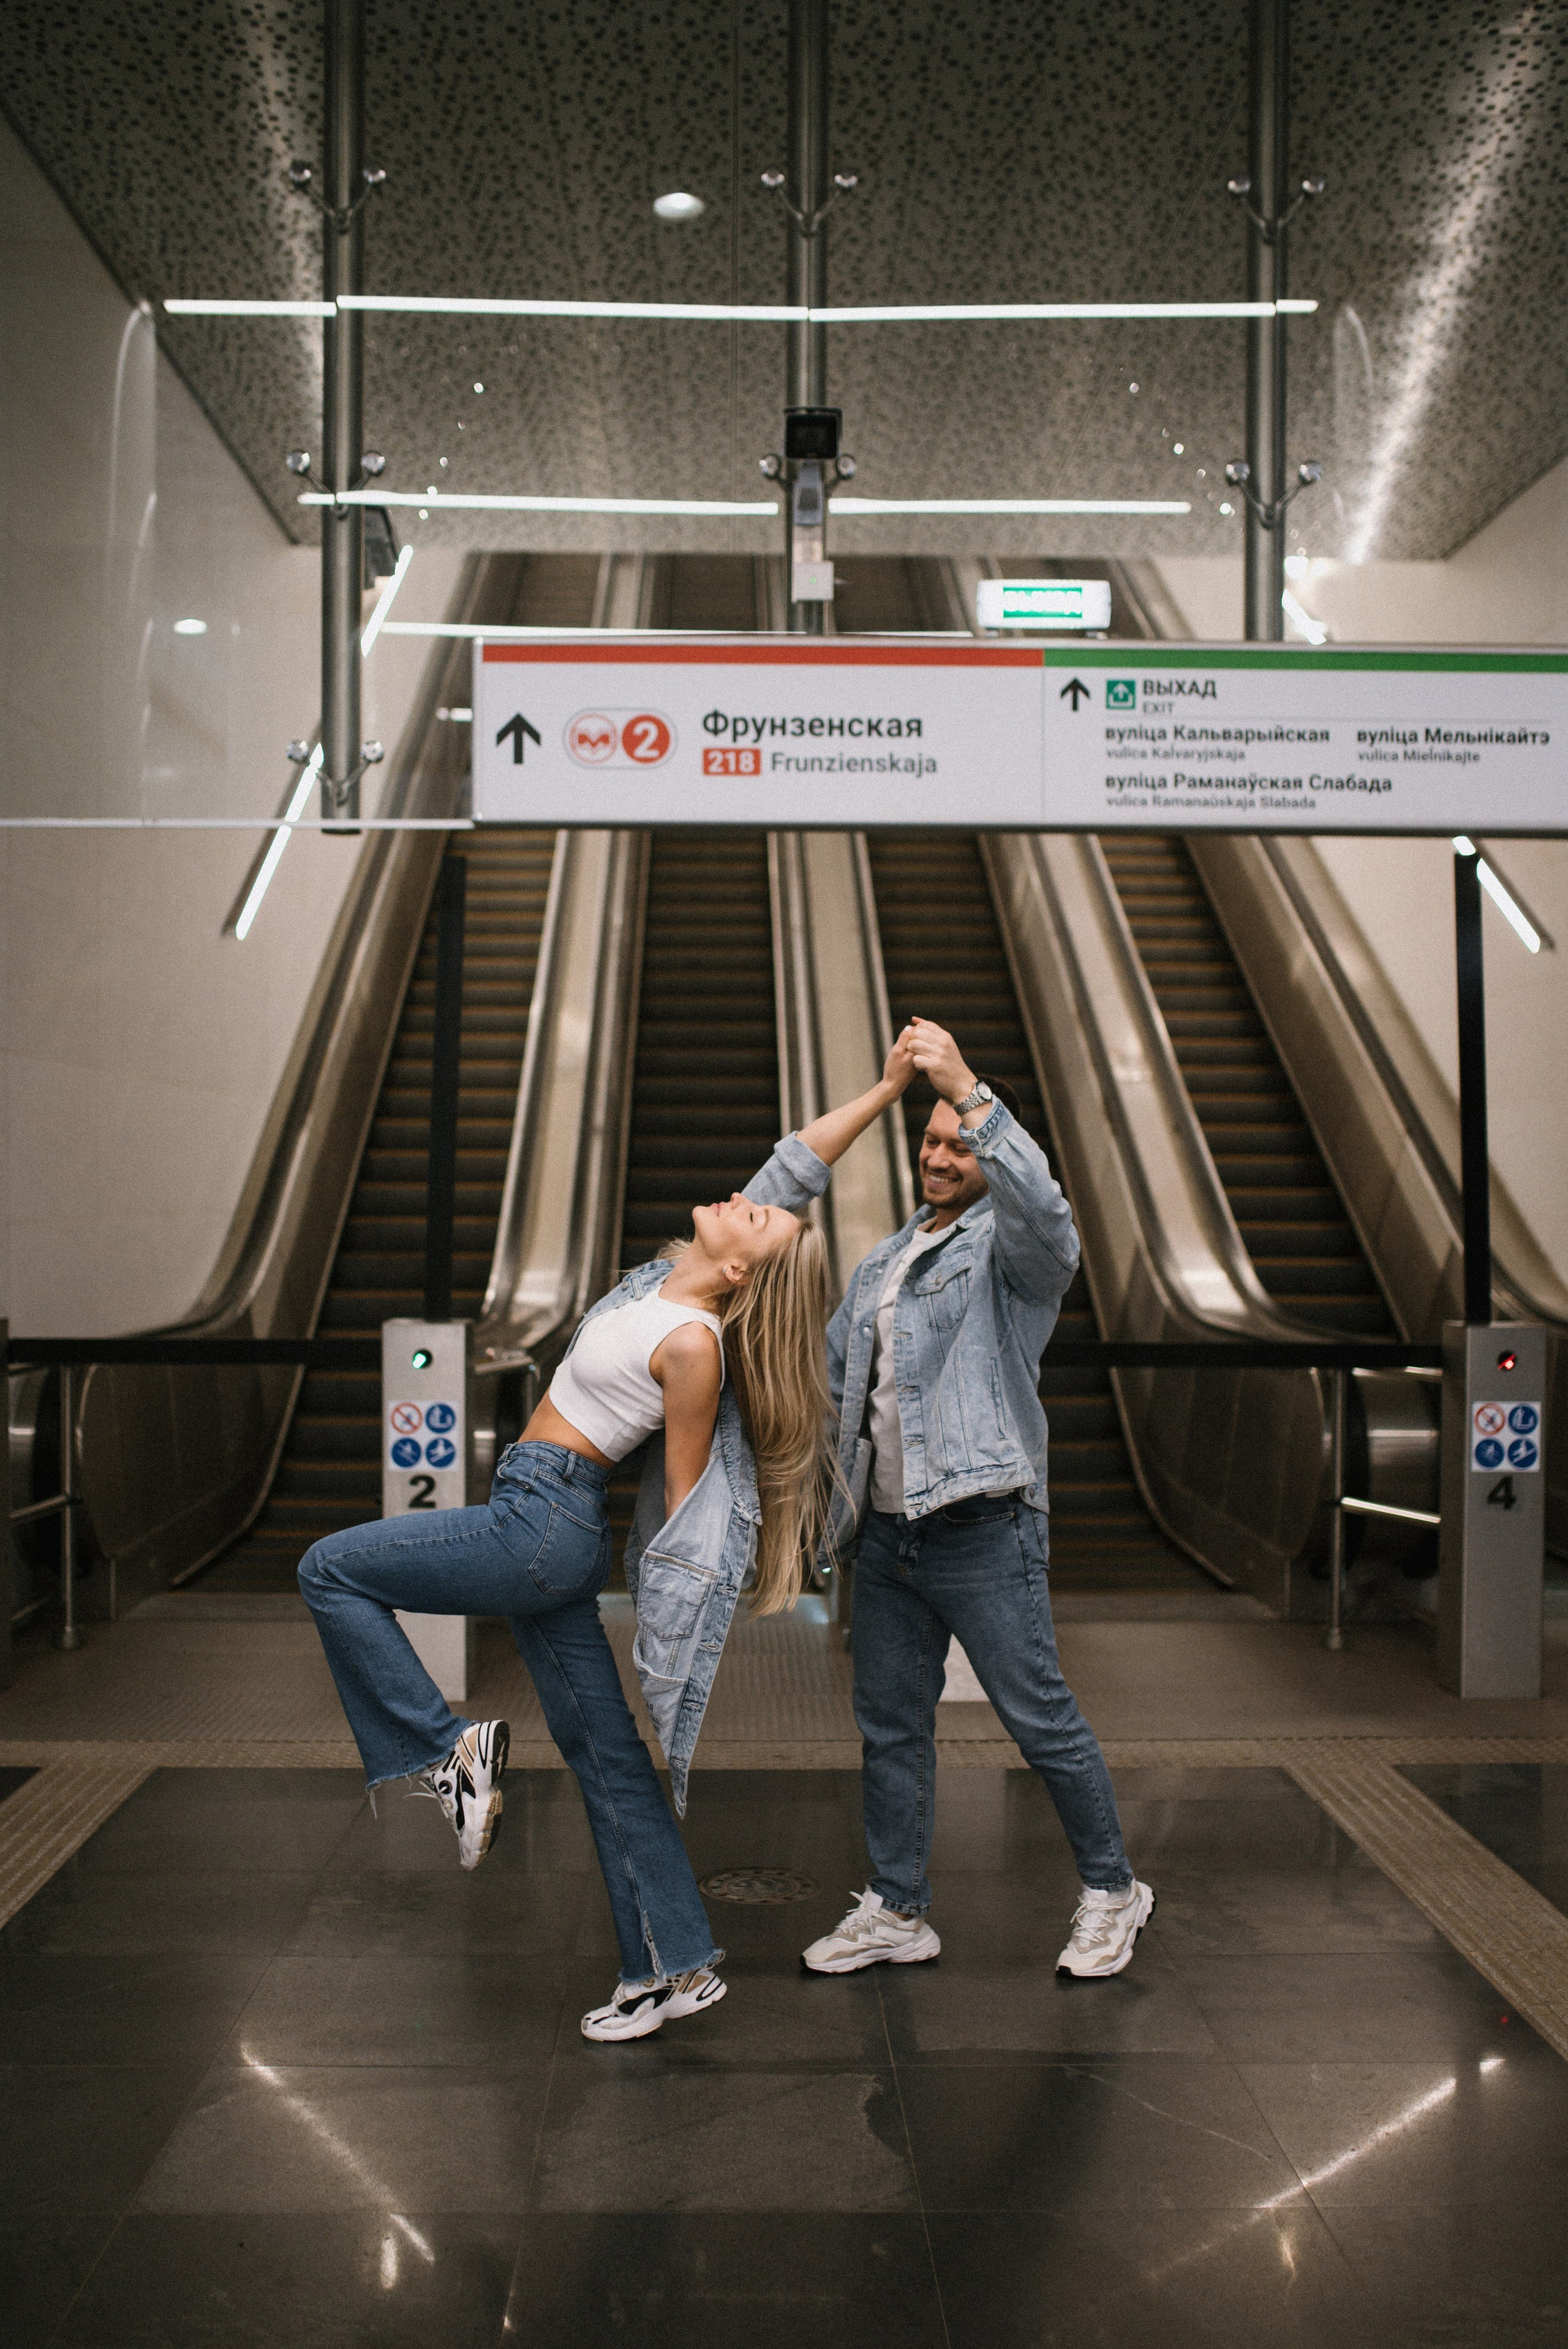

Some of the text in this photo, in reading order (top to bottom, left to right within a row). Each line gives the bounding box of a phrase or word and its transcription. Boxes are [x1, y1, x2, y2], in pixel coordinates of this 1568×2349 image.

[1143, 679, 1217, 699] ВЫХАД
[1143, 702, 1174, 714] EXIT
[703, 709, 922, 743] Фрунзенская
[1106, 725, 1330, 745] вуліца Кальварыйская
[1357, 726, 1550, 747] вуліца Мельнікайтэ
[633, 721, 660, 758] 2
[1107, 747, 1148, 760] vulica
[1359, 748, 1399, 762] vulica
[707, 750, 937, 779] 218 Frunzienskaja
[1106, 772, 1393, 793] вуліца Раманаўская Слабада
[409, 1474, 437, 1509] 2
[1487, 1475, 1517, 1510] 4
